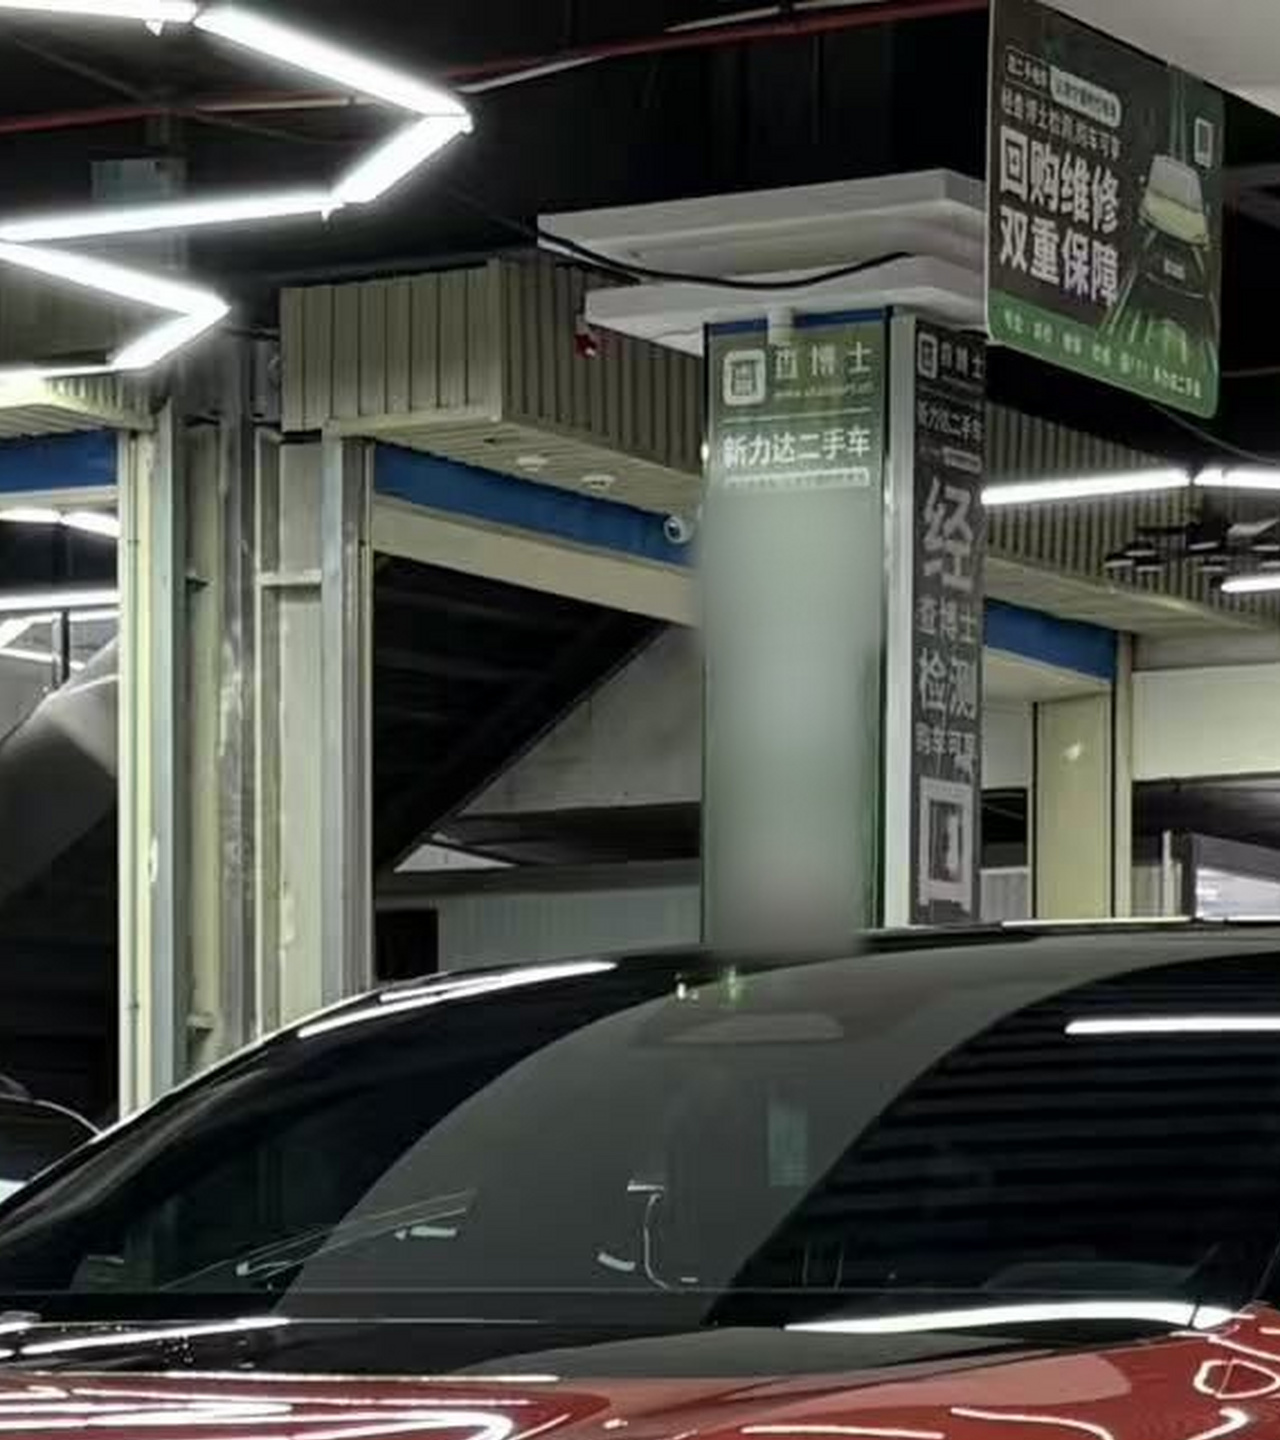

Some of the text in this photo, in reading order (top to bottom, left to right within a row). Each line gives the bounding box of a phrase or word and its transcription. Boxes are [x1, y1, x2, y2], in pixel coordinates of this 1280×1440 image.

[1000, 125, 1118, 234] 回购维修
[1000, 204, 1118, 306] 双重保障
[723, 424, 871, 469] 新力达二手车
